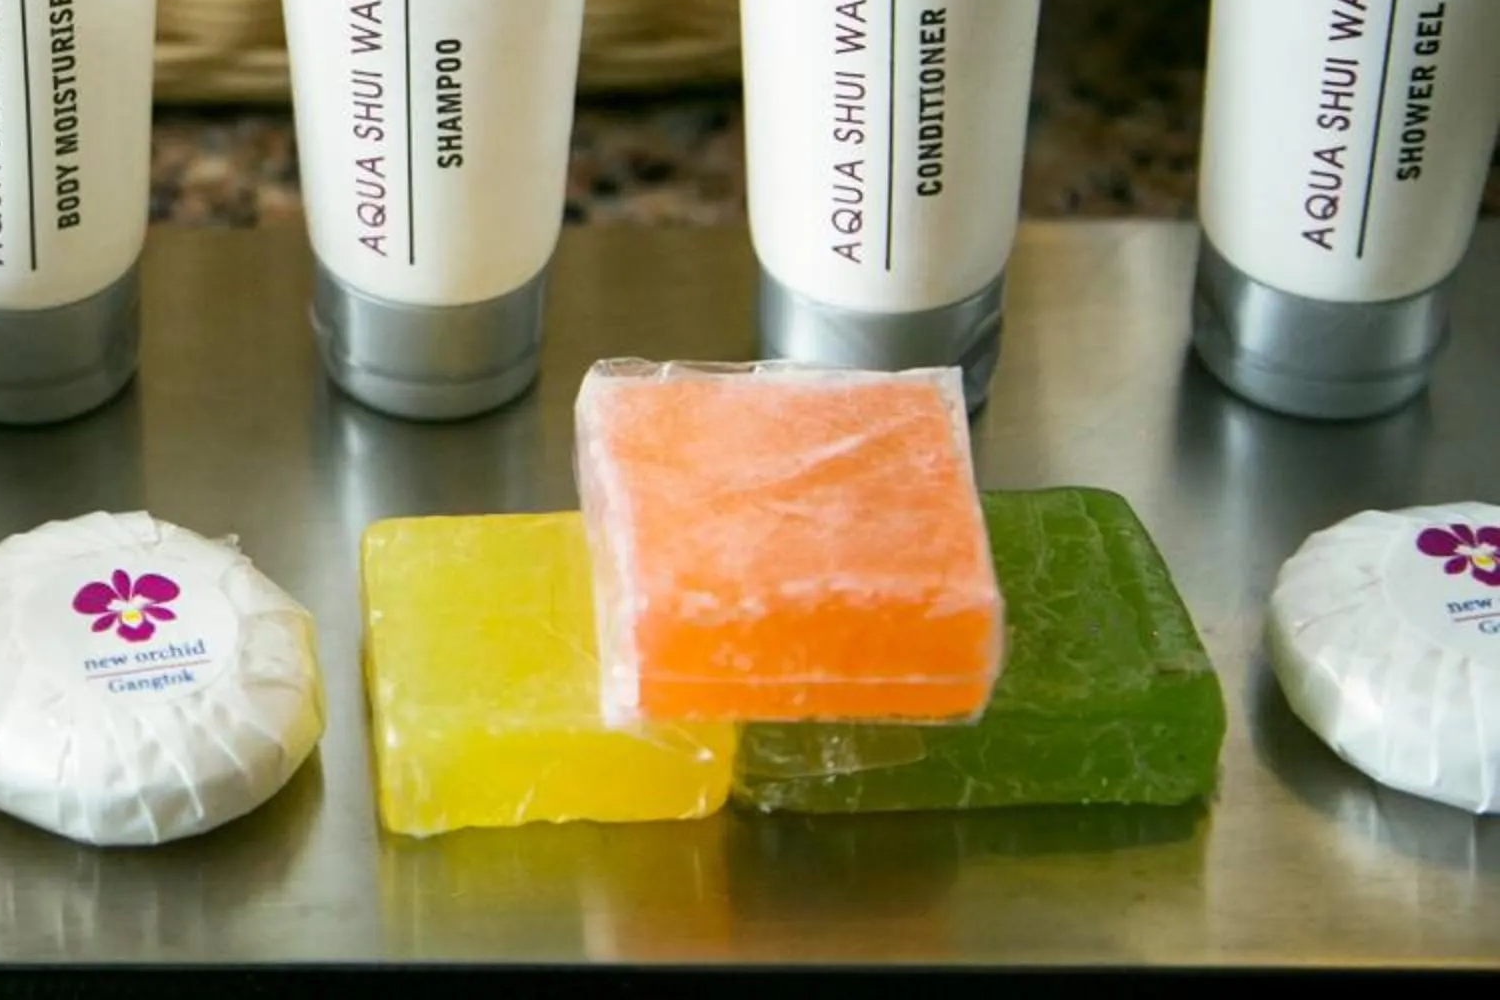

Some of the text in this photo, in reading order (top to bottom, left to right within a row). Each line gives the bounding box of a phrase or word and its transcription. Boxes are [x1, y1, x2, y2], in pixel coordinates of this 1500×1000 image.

[353, 71, 384, 142] SHUI
[435, 38, 462, 168] SHAMPOO
[833, 71, 865, 144] SHUI
[917, 7, 946, 196] CONDITIONER
[1318, 58, 1358, 131] SHUI
[1396, 2, 1445, 181] SHOWER GEL
[55, 162, 80, 230] BODY
[357, 155, 387, 257] AQUA
[831, 159, 863, 264] AQUA
[1302, 145, 1347, 250] AQUA
[1447, 599, 1492, 613] new
[84, 639, 206, 671] new orchid
[109, 669, 194, 693] Gangtok
